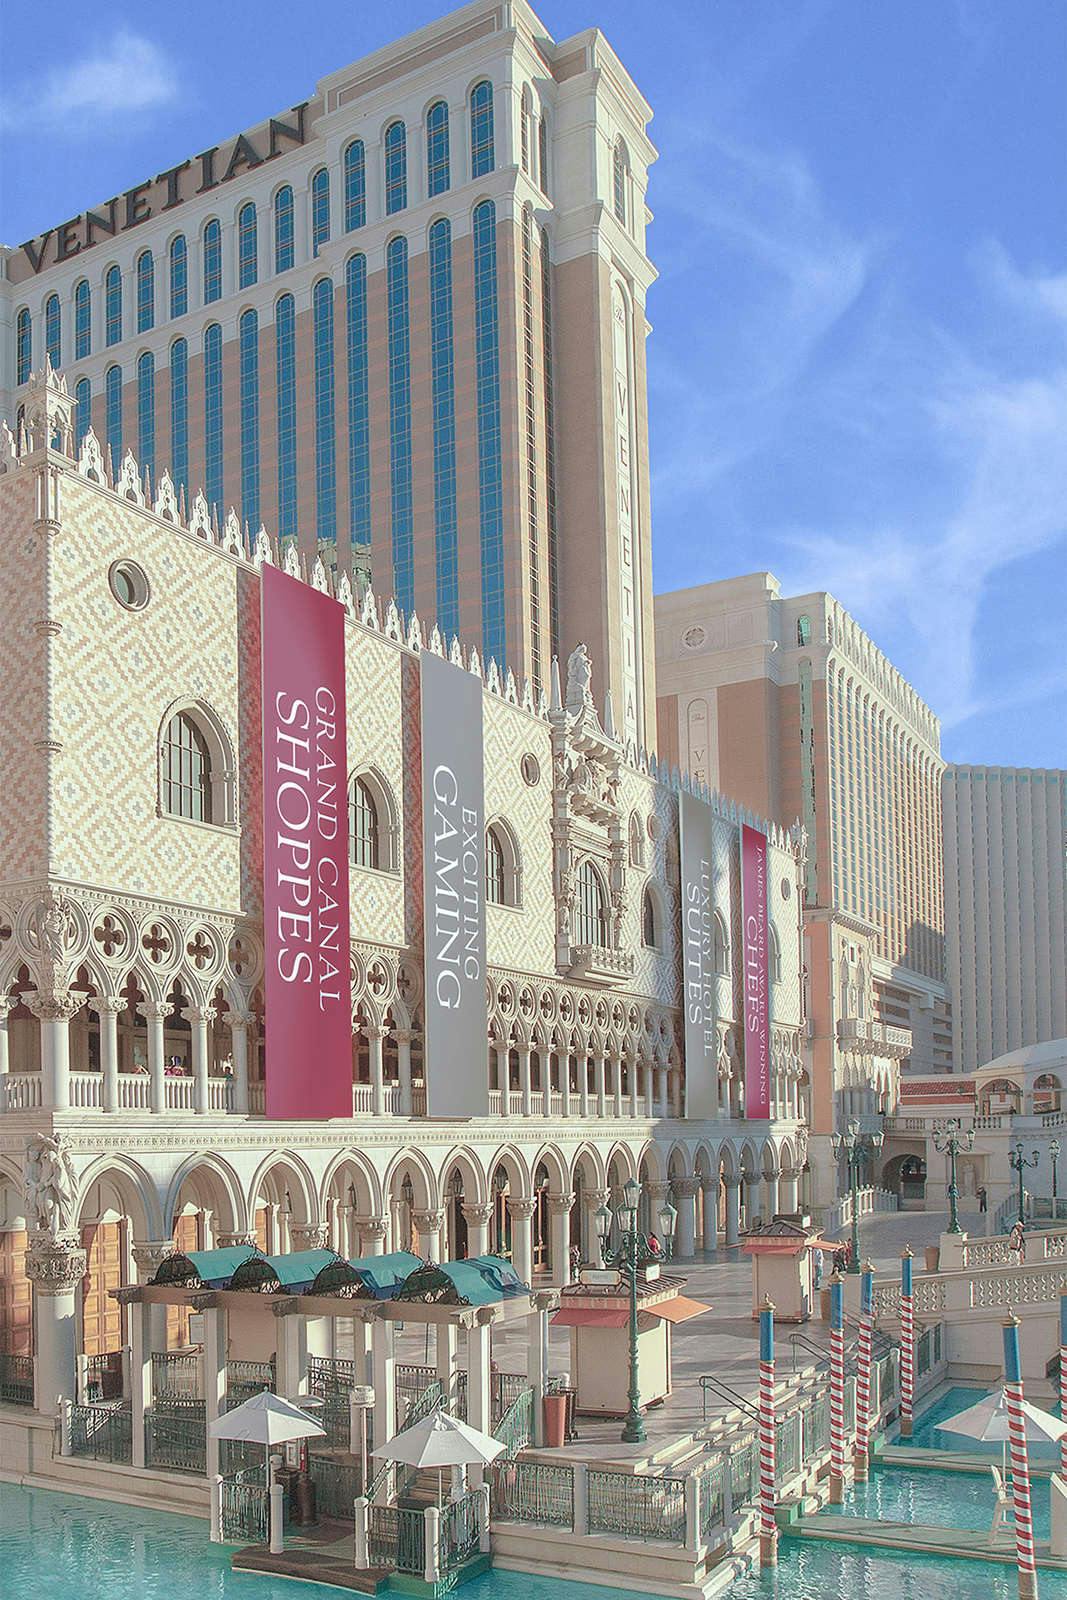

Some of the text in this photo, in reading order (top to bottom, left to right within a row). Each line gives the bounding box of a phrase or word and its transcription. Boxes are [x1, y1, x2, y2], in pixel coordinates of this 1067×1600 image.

[18, 102, 309, 274] VENETIAN
[275, 691, 313, 984] SHOPPES
[314, 686, 341, 1012] GRAND CANAL
[432, 764, 461, 1010] GAMING
[461, 806, 480, 982] EXCITING
[687, 882, 702, 1025] SUITES
[700, 859, 712, 1056] LUXURY HOTEL
[747, 915, 758, 1033] CHEFS
[757, 903, 765, 959] BEARD
[758, 963, 766, 1024] AWARD
[759, 1029, 767, 1105] WINNING
